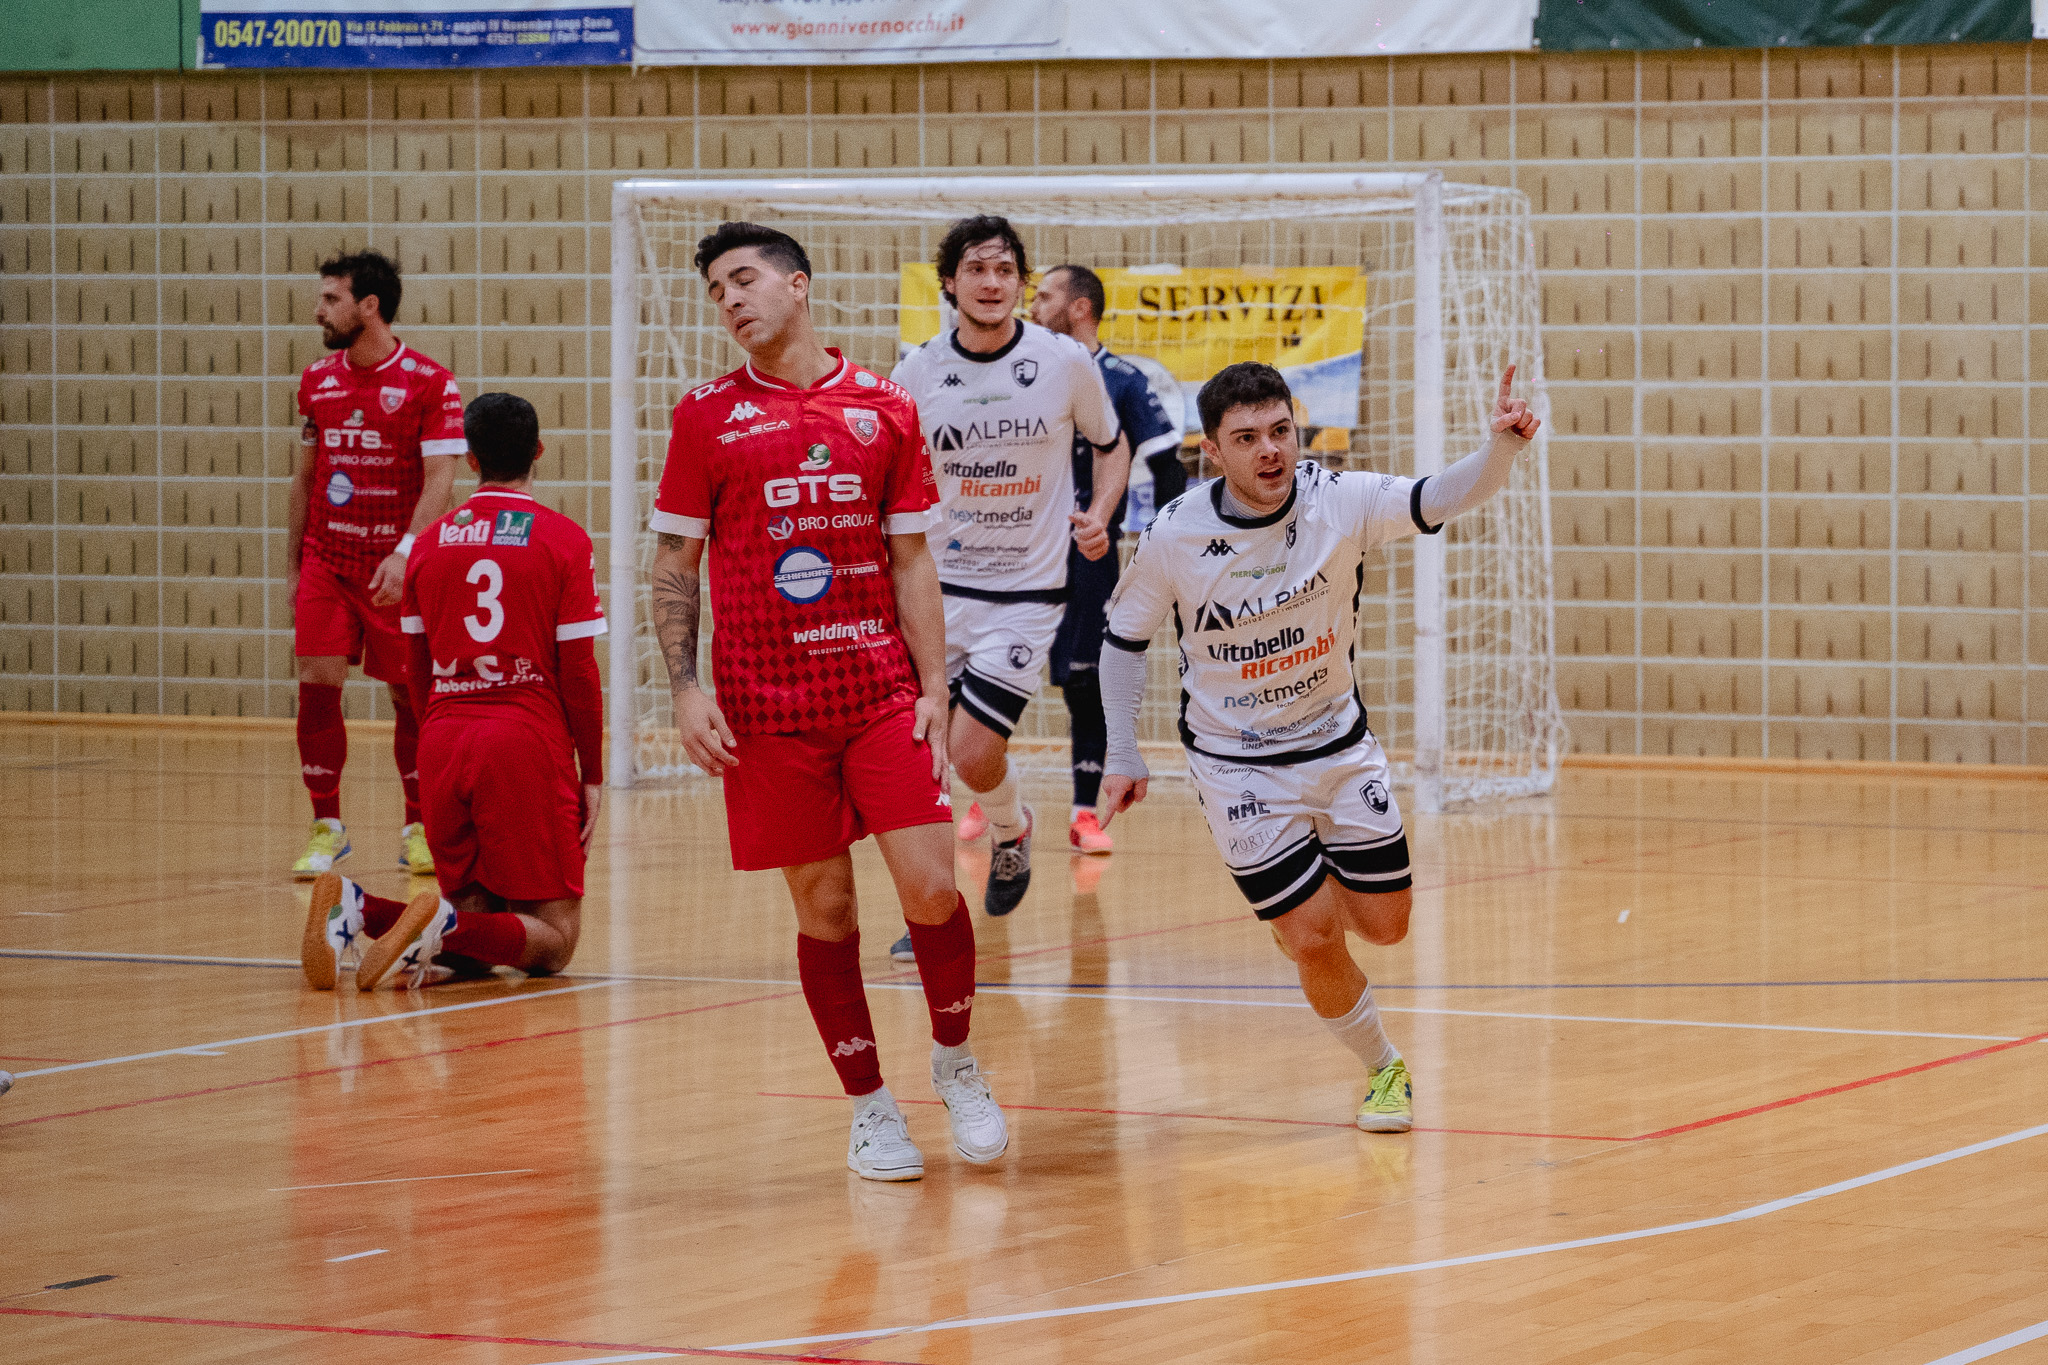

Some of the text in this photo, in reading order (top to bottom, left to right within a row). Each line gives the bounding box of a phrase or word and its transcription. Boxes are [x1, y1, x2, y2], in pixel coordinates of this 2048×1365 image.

[215, 20, 341, 48] 0547-20070
[731, 14, 965, 39] www.giannivernocchi.it
[324, 428, 382, 449] GTS
[716, 420, 790, 445] TELECA
[966, 416, 1048, 441] ALPHA
[764, 474, 862, 508] GTS
[960, 475, 1042, 497] Ricambi
[798, 516, 828, 531] BRO
[949, 506, 1033, 523] nextmedia
[439, 519, 491, 544] lenti
[463, 559, 505, 643] 3
[1281, 588, 1330, 613] immobiliar
[860, 619, 885, 636] F&L
[1207, 626, 1305, 662] Vitobello
[1242, 627, 1335, 680] Ricambi
[1224, 667, 1328, 709] nextmeda
[1227, 802, 1271, 821] NMC
[1228, 825, 1283, 856] HORTUS
